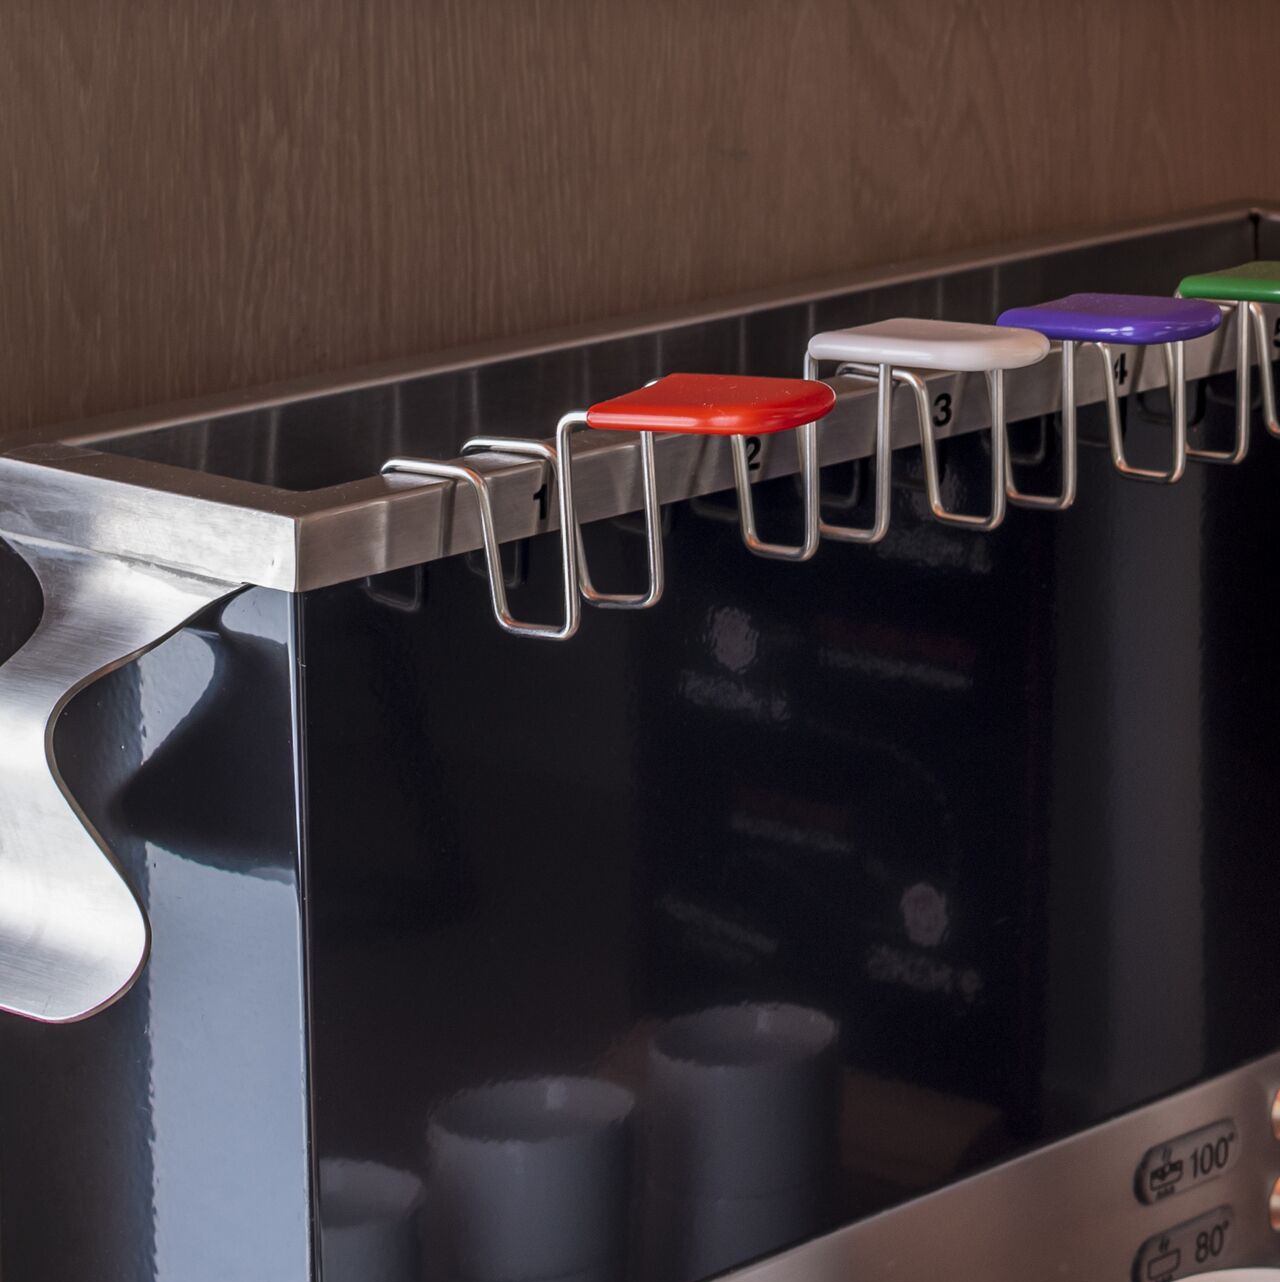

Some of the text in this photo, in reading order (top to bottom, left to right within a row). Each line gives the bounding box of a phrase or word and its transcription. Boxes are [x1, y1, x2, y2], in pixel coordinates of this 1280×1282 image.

[1113, 352, 1128, 385] 4
[932, 392, 953, 426] 3
[745, 436, 761, 471] 2
[532, 483, 548, 520] 1
[1190, 1132, 1235, 1179] 100°
